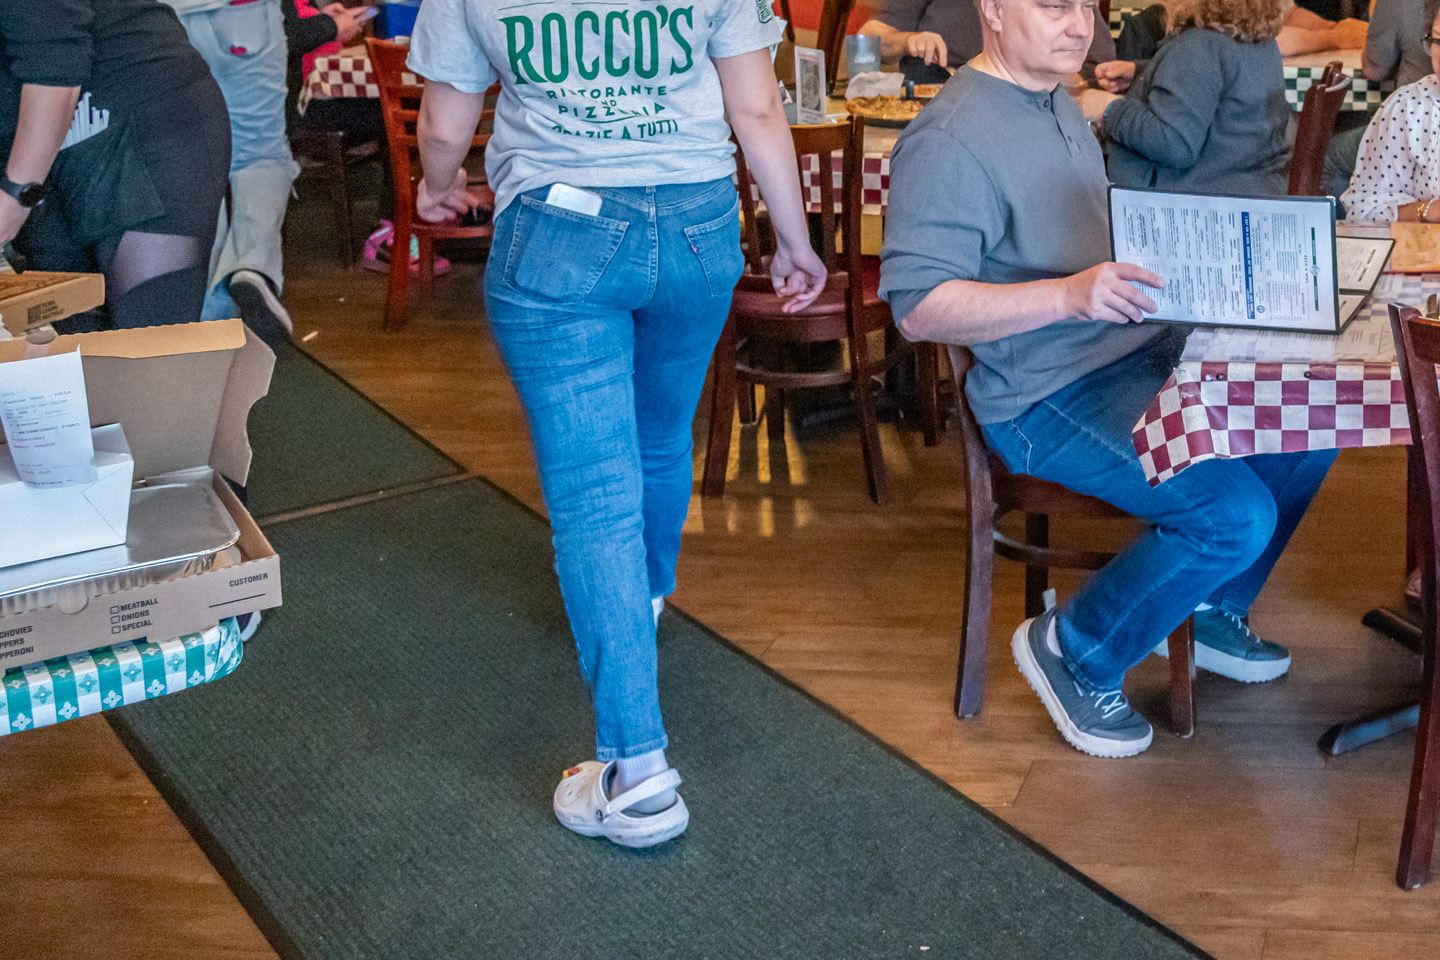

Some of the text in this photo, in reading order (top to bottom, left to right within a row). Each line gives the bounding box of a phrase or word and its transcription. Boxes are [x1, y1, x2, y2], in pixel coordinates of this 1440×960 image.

[498, 4, 695, 85] ROCCO'S
[622, 126, 632, 139] A
[637, 119, 678, 138] TUTTI
[229, 572, 268, 587] CUSTOMER
[120, 597, 159, 612] MEATBALL
[121, 610, 150, 622] ONIONS
[122, 620, 153, 632] SPECIAL
